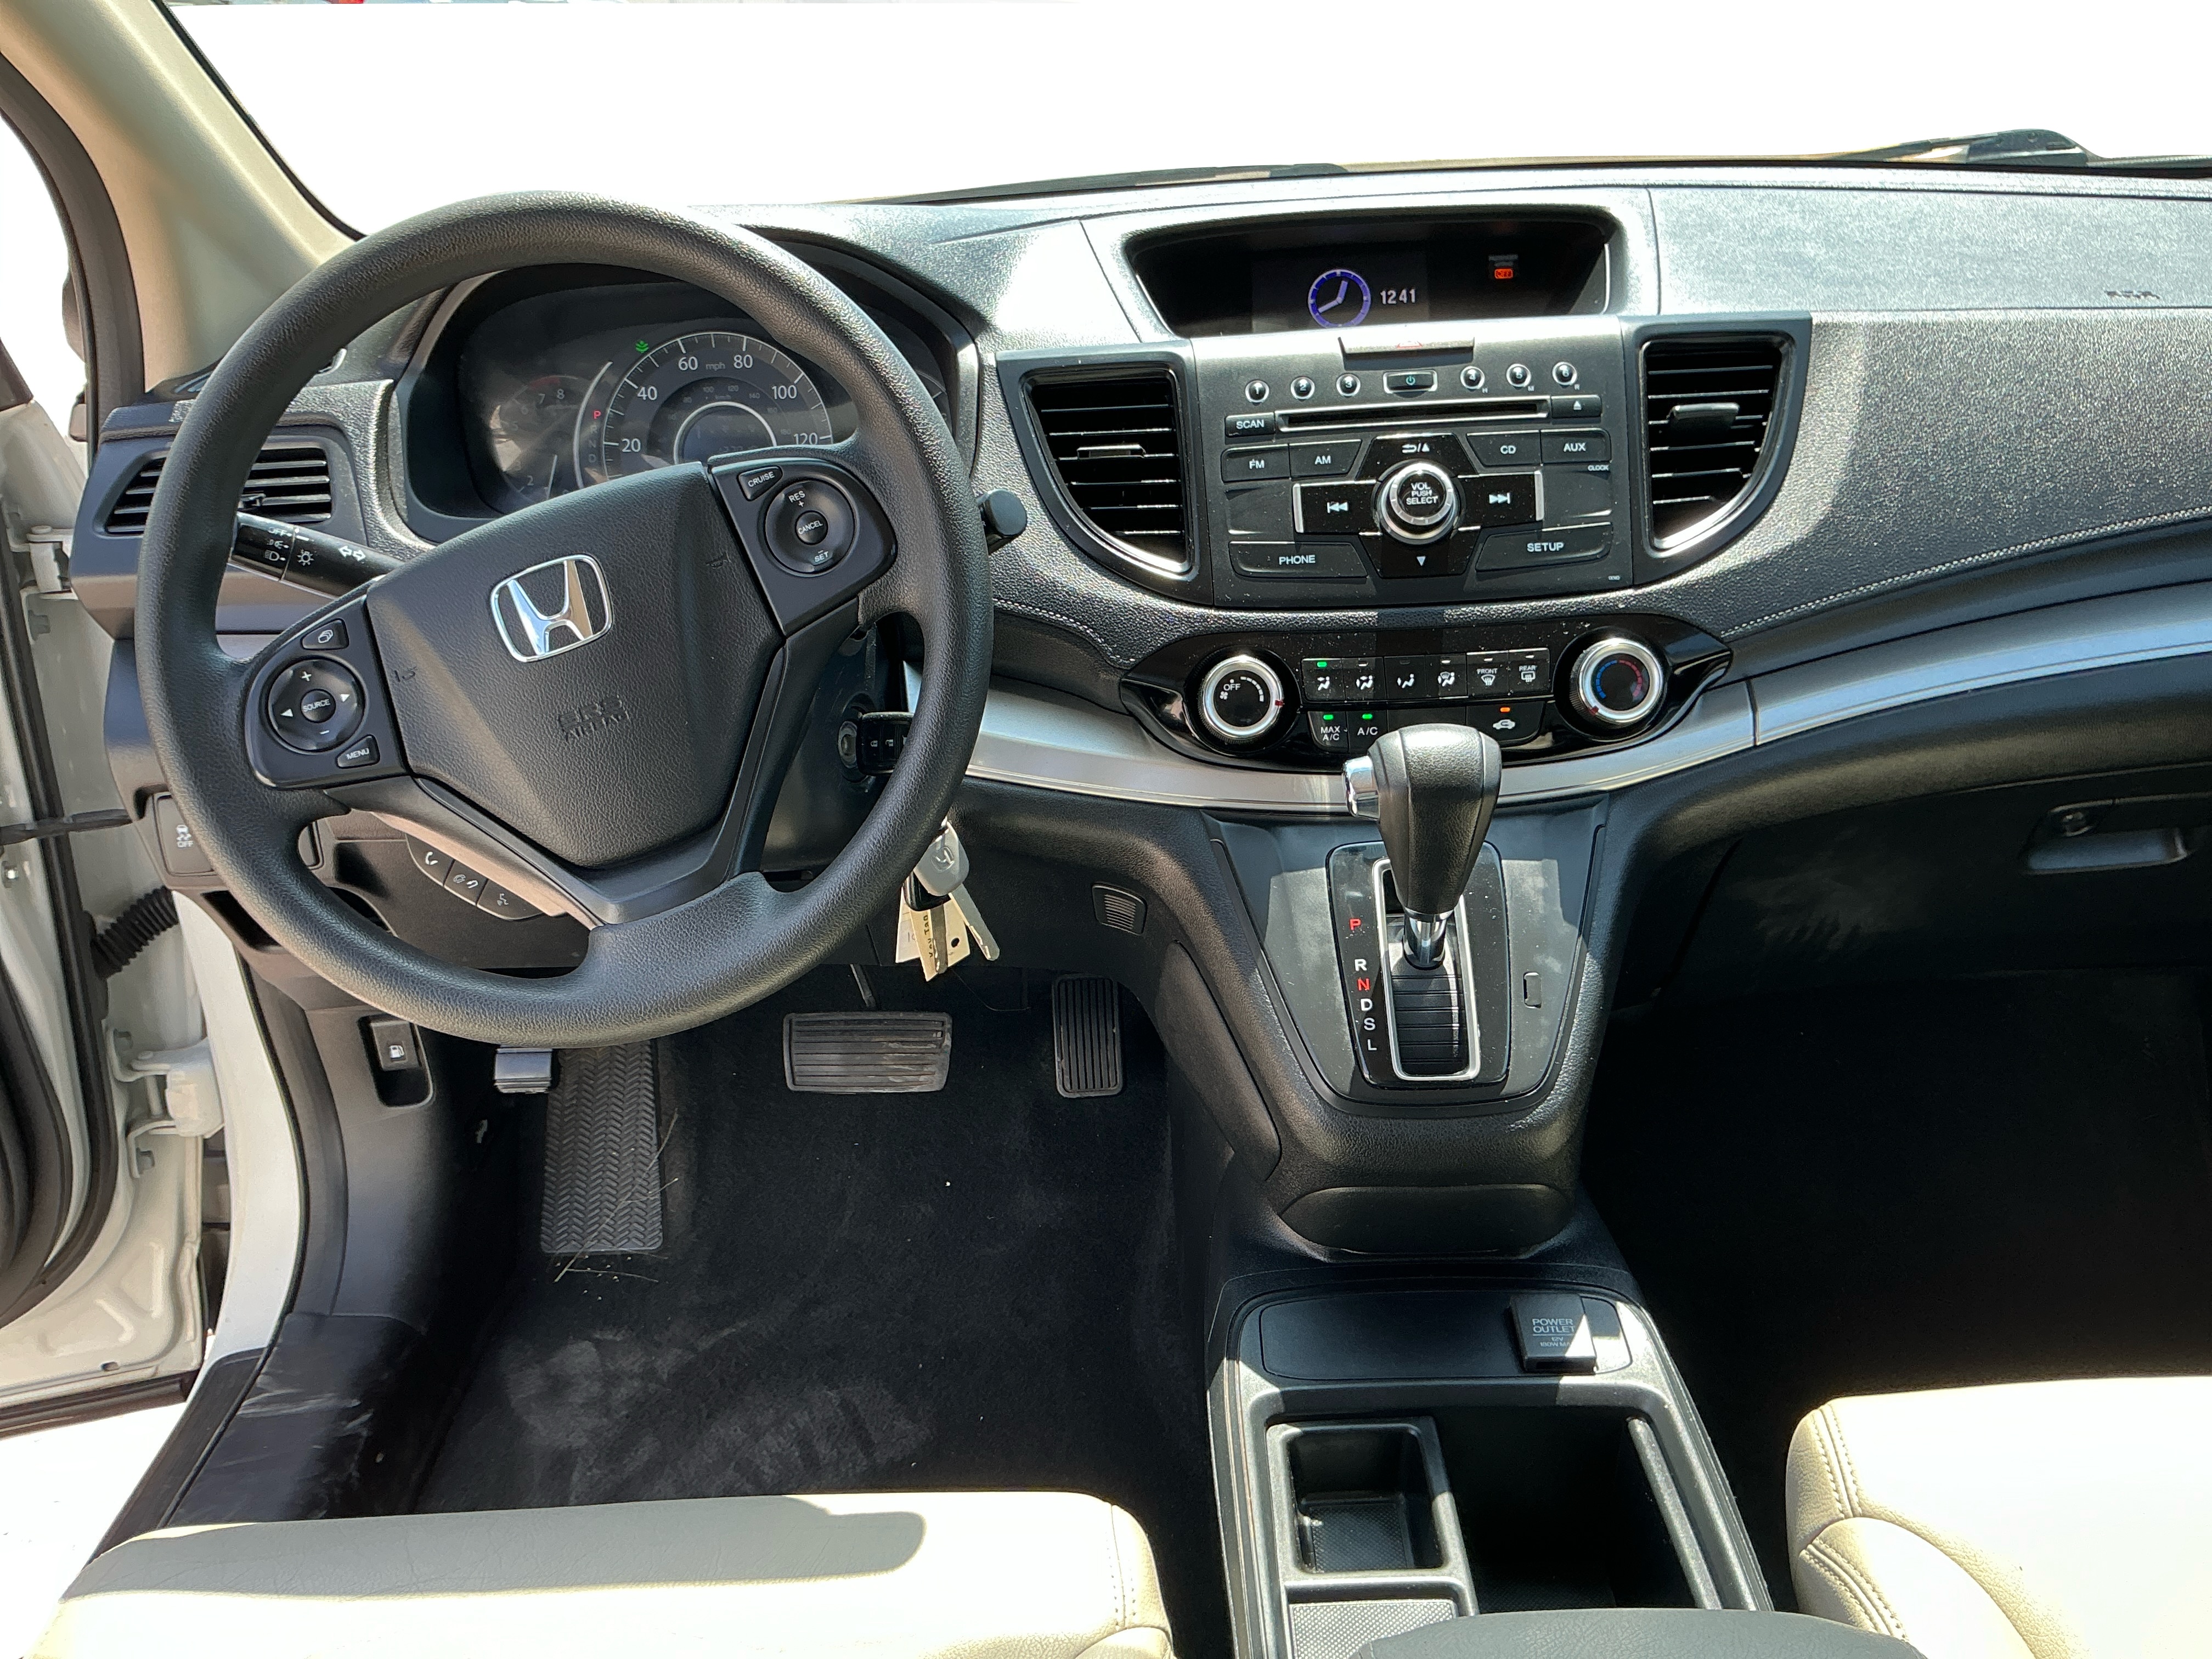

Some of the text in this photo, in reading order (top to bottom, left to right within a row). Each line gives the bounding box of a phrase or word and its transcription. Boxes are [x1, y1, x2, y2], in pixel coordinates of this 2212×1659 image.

[678, 357, 698, 371] 60
[706, 362, 726, 371] mph
[733, 354, 753, 369] 80
[538, 393, 546, 404] 7
[557, 389, 565, 399] 8
[637, 386, 657, 401] 40
[771, 385, 797, 400] 100
[594, 410, 601, 419] P
[1235, 420, 1265, 430] SCAN
[793, 432, 818, 445] 120
[622, 438, 641, 453] 20
[1500, 445, 1517, 454] CD
[1564, 442, 1587, 452] AUX
[1249, 460, 1265, 470] FM
[1314, 455, 1331, 465] AM
[527, 475, 534, 486] 2
[748, 471, 775, 488] CRUISE
[1410, 482, 1431, 490] VOL
[788, 490, 806, 503] RES
[1406, 495, 1438, 505] SELECT
[798, 520, 823, 535] CANCEL
[1526, 541, 1564, 553] SETUP
[814, 551, 829, 563] SET
[1278, 555, 1316, 566] PHONE
[1223, 683, 1241, 691] OFF
[303, 698, 331, 712] SOURCE
[1320, 725, 1340, 734] MAX
[1357, 726, 1378, 736] A/C
[1322, 733, 1340, 741] A/C
[346, 747, 370, 760] MENU
[1350, 918, 1361, 930] P
[1355, 958, 1367, 971] R
[1357, 978, 1370, 991] N
[1361, 998, 1373, 1012] D
[1363, 1017, 1376, 1031] S
[1367, 1039, 1377, 1051] L
